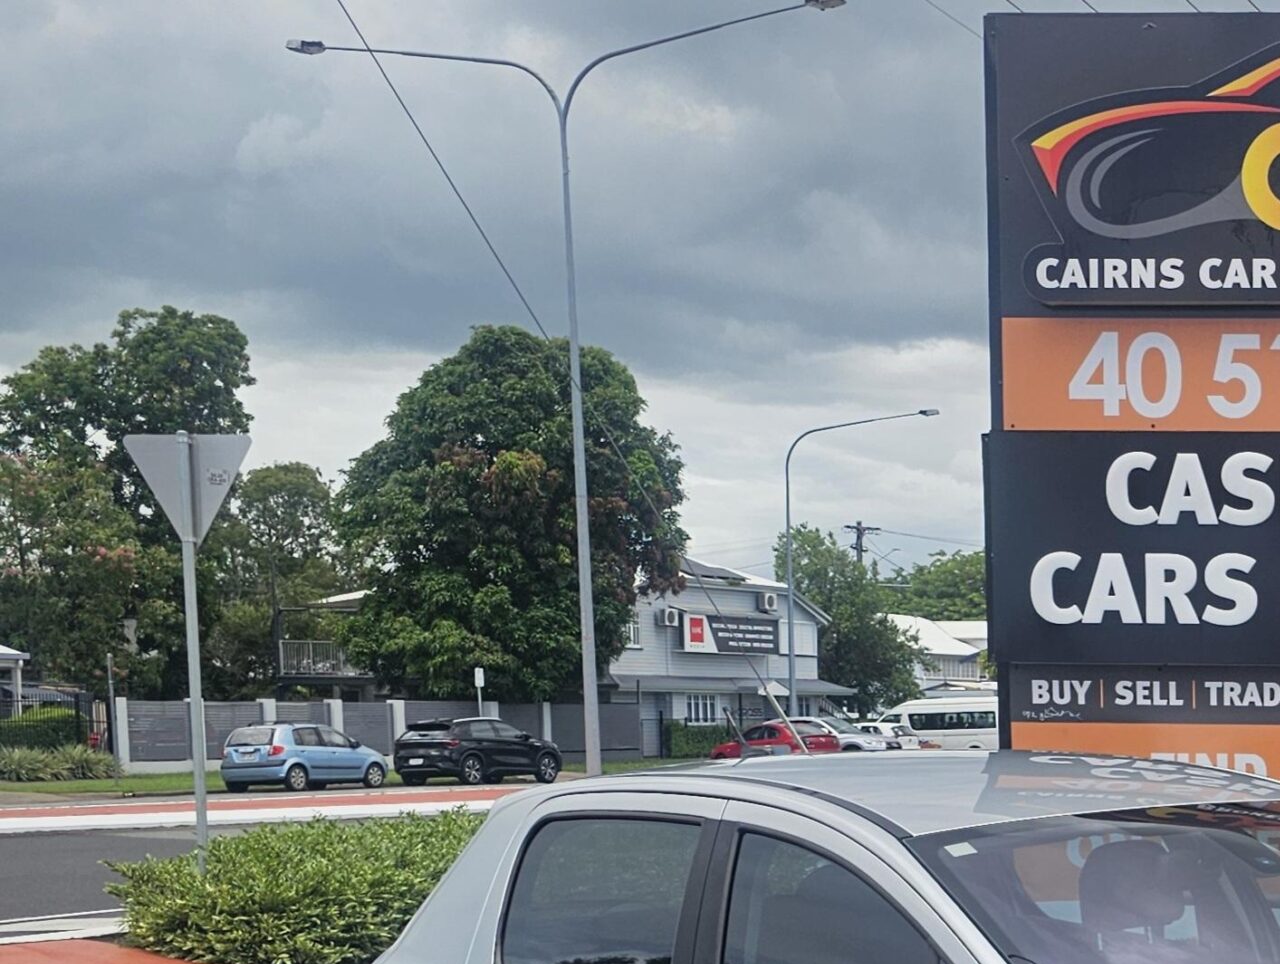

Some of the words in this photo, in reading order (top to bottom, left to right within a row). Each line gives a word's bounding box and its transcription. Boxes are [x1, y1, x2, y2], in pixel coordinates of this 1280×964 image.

[1035, 257, 1185, 289] CAIRNS
[1199, 258, 1277, 289] CAR
[1068, 331, 1183, 418] 40
[1030, 550, 1258, 626] CARS
[1031, 679, 1092, 705] BUY
[1114, 680, 1184, 706] SELL
